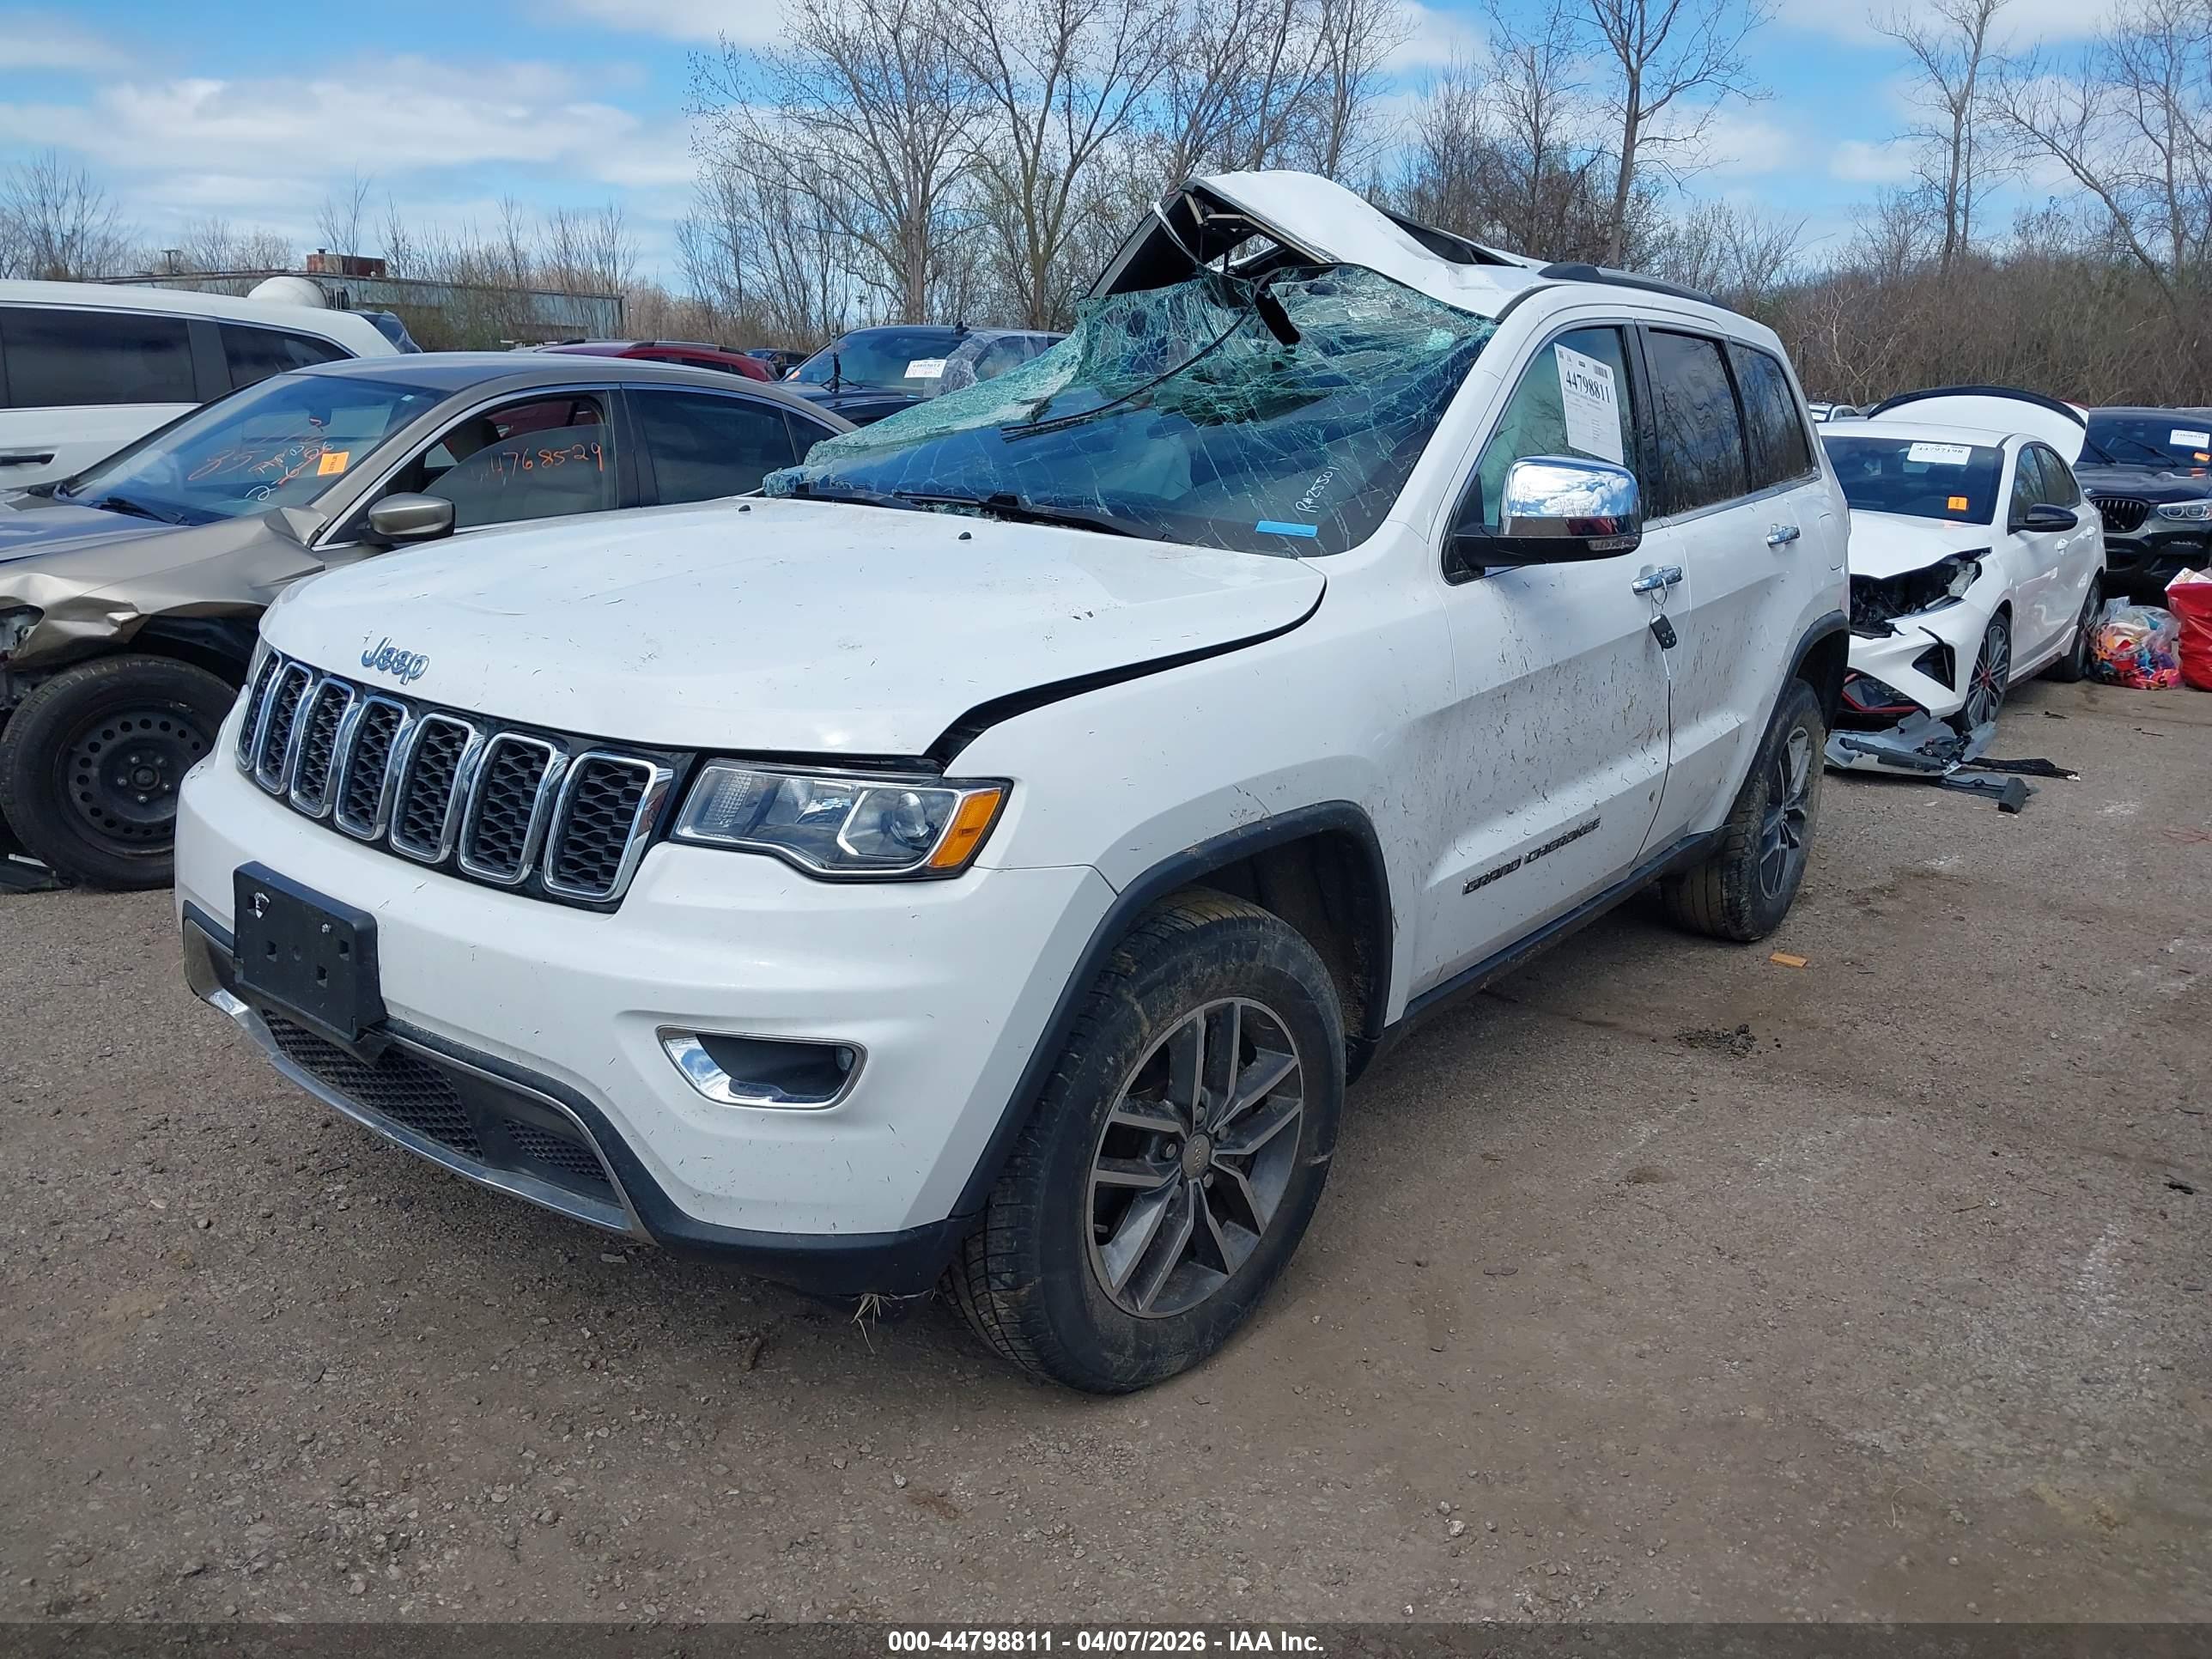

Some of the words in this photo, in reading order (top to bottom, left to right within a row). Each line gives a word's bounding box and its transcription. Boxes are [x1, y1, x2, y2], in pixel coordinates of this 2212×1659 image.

[1566, 368, 1610, 404] 44798811
[361, 635, 430, 686] Jeep
[1462, 858, 1522, 896] GRAND
[1524, 815, 1601, 865] CHEROKEE
